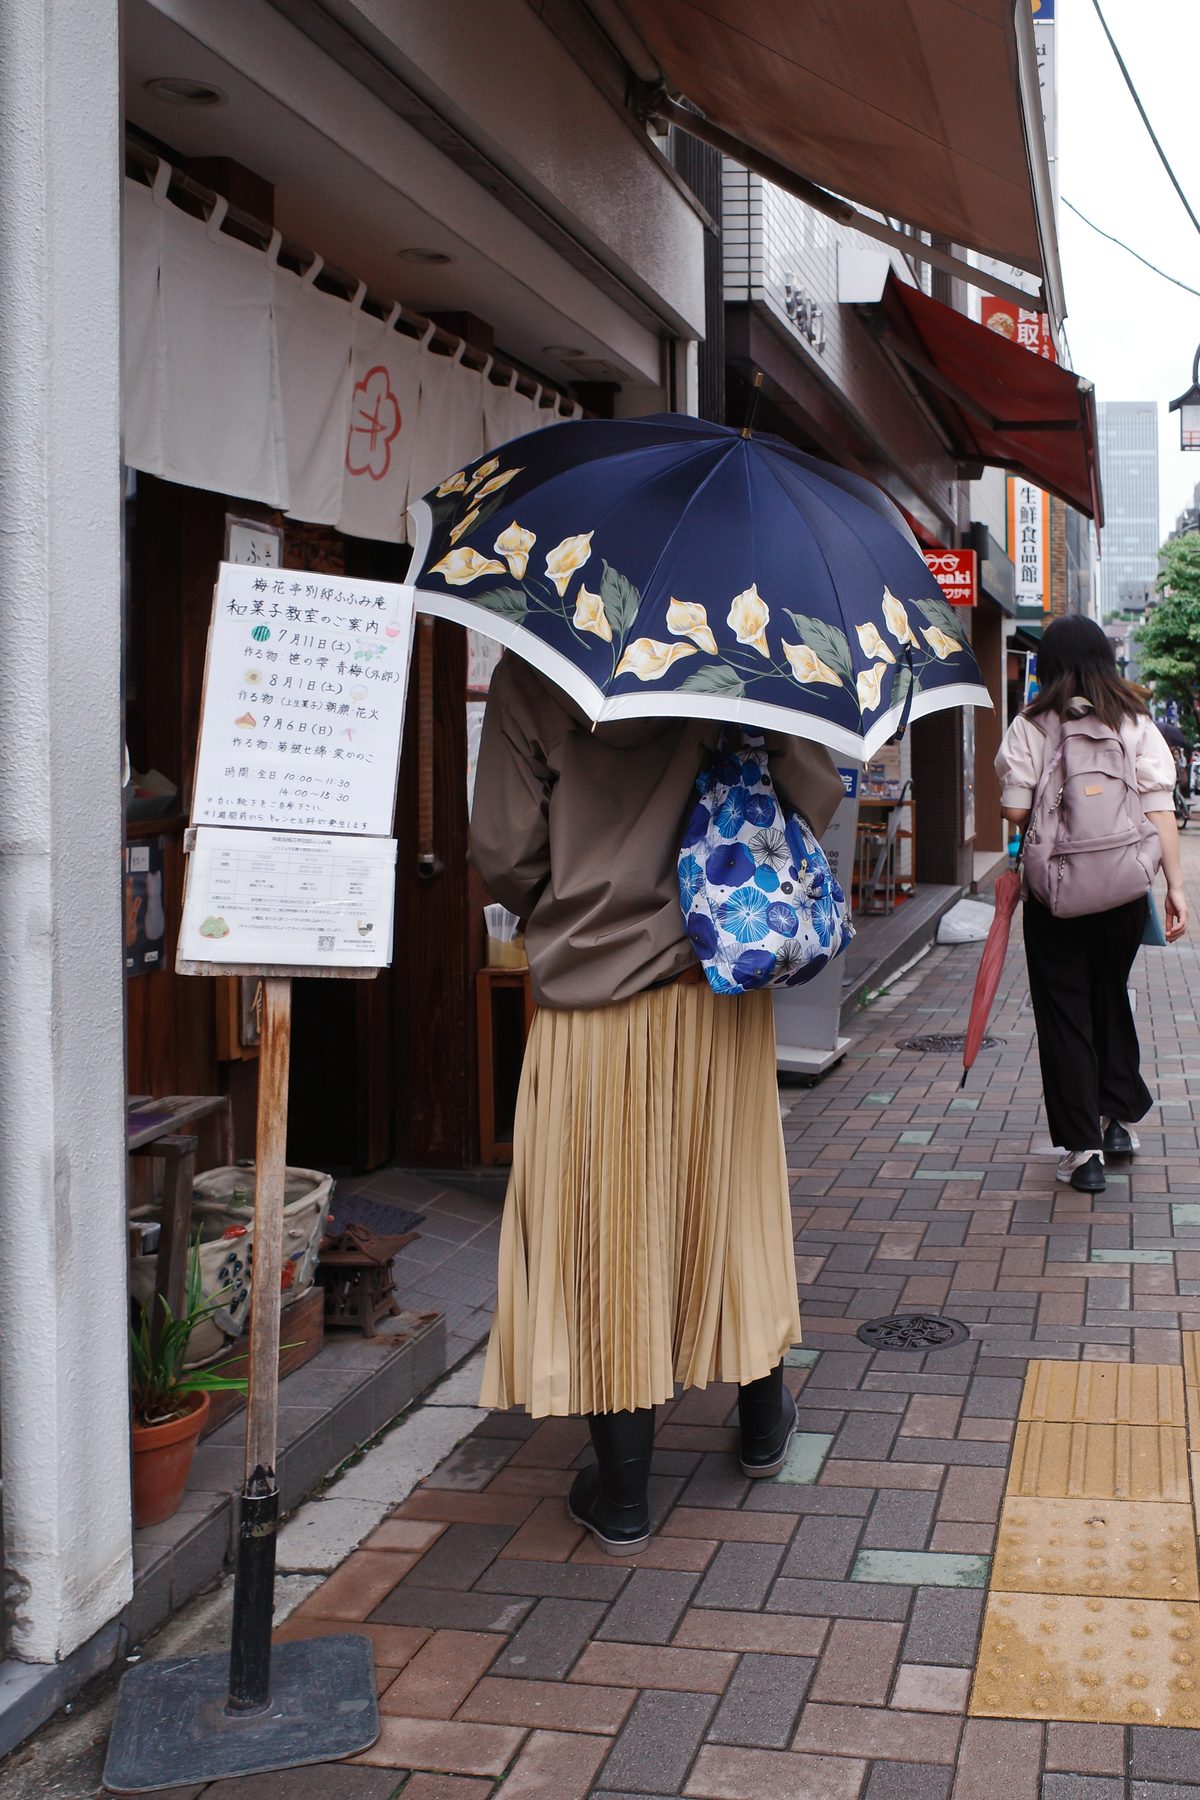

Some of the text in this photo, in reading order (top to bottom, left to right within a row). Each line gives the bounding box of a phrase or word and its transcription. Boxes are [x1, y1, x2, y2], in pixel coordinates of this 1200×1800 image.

[1020, 487, 1038, 583] 生鮮食品館
[252, 578, 387, 611] 梅花亭別邸ふふみ庵
[226, 598, 379, 635] 和菓子教室のご案内
[278, 629, 352, 655] 7月11日(土)
[269, 674, 343, 695] 8月1日(土)
[262, 715, 333, 737] 9月6日(日)
